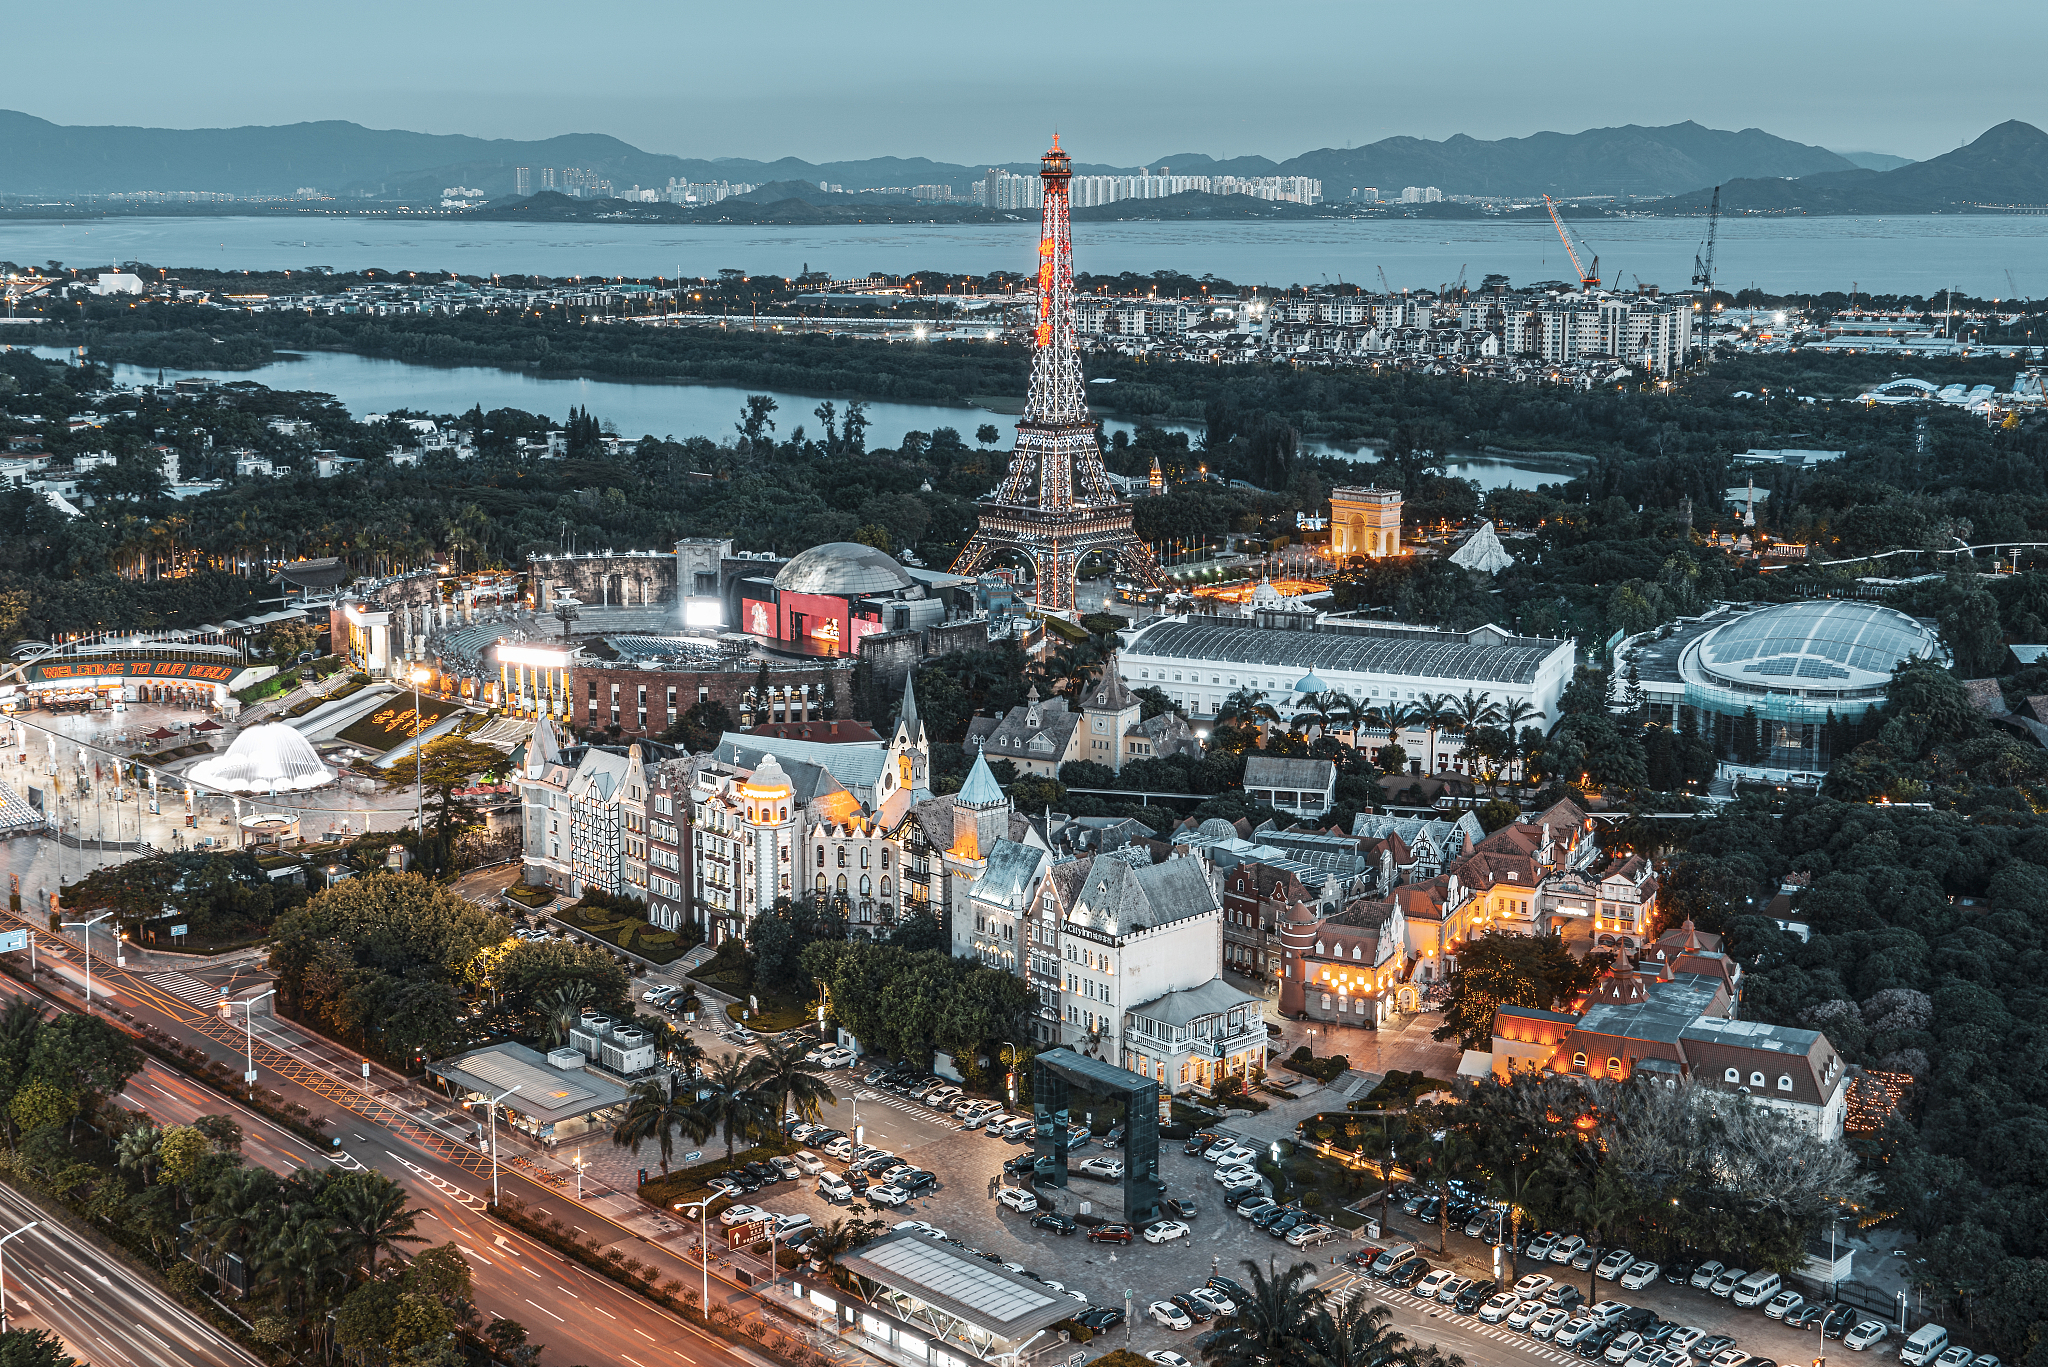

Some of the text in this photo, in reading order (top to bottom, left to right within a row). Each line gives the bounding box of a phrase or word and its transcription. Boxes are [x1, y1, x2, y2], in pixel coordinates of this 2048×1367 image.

[42, 662, 232, 680] WELCOME TO OUR WORLD
